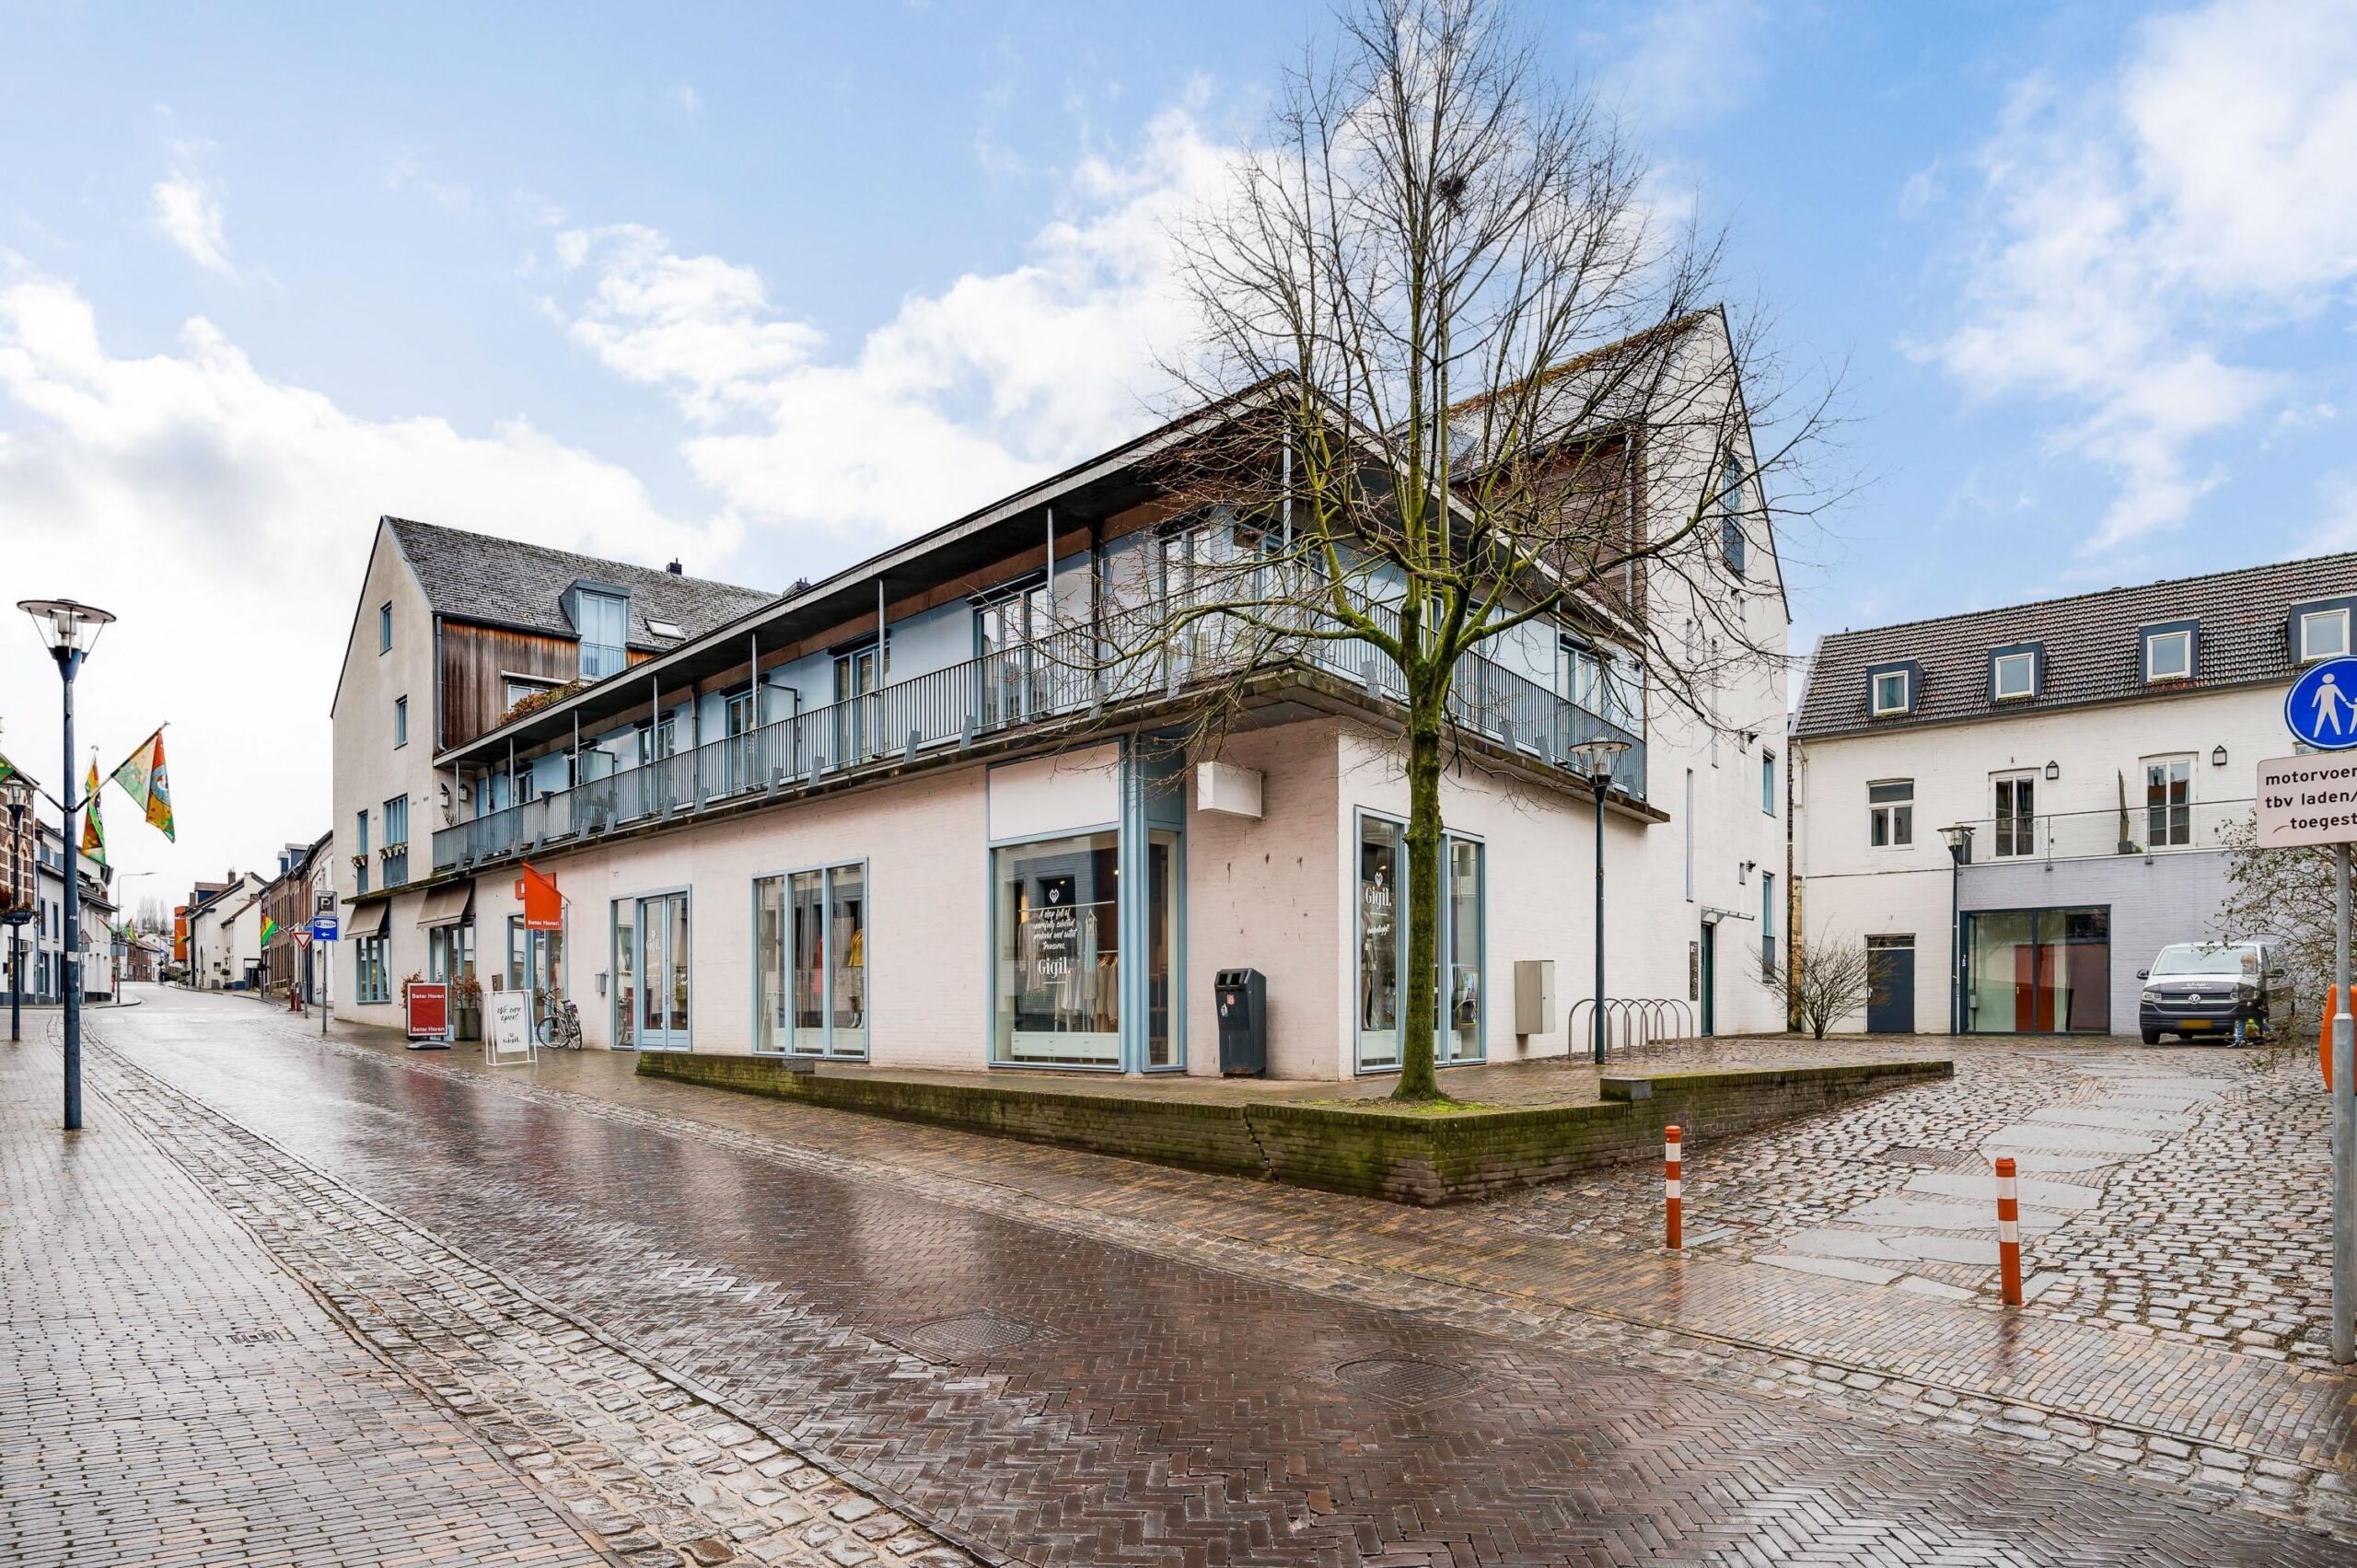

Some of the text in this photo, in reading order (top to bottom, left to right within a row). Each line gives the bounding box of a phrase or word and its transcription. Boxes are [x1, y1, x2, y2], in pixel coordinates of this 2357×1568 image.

[2265, 791, 2357, 808] tbv laden/
[2290, 812, 2357, 831] toegest
[320, 898, 331, 911] P
[1365, 886, 1391, 909] Gigil.
[1038, 957, 1071, 978] Gigil.
